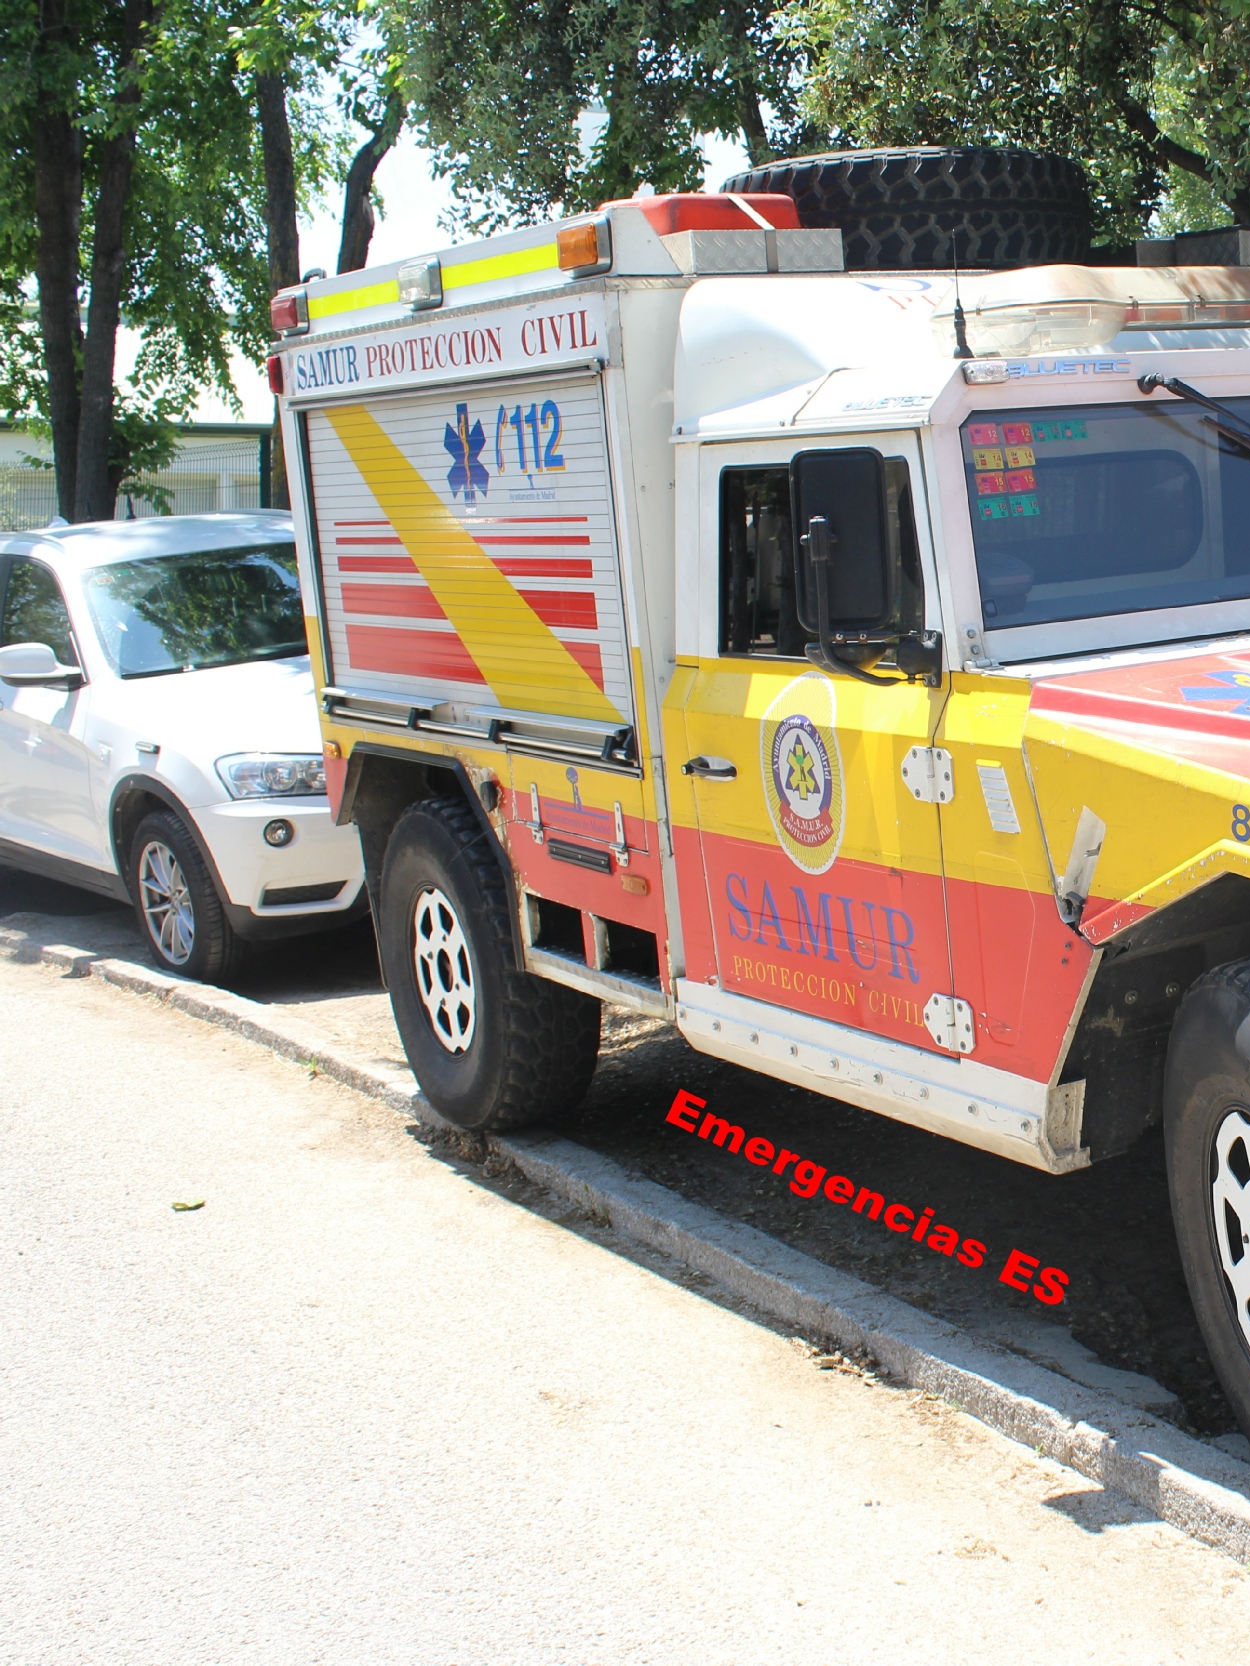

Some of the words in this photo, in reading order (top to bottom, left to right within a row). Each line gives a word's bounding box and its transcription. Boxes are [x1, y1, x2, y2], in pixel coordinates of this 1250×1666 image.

[297, 345, 360, 390] SAMUR
[365, 327, 503, 378] PROTECCION
[521, 309, 597, 356] CIVIL
[1007, 359, 1132, 379] BLUETEC
[509, 400, 566, 473] 112
[803, 720, 812, 734] de
[813, 733, 832, 779] Madrid
[725, 872, 921, 985] SAMUR
[733, 955, 856, 1007] PROTECCION
[868, 989, 924, 1028] CIVIL
